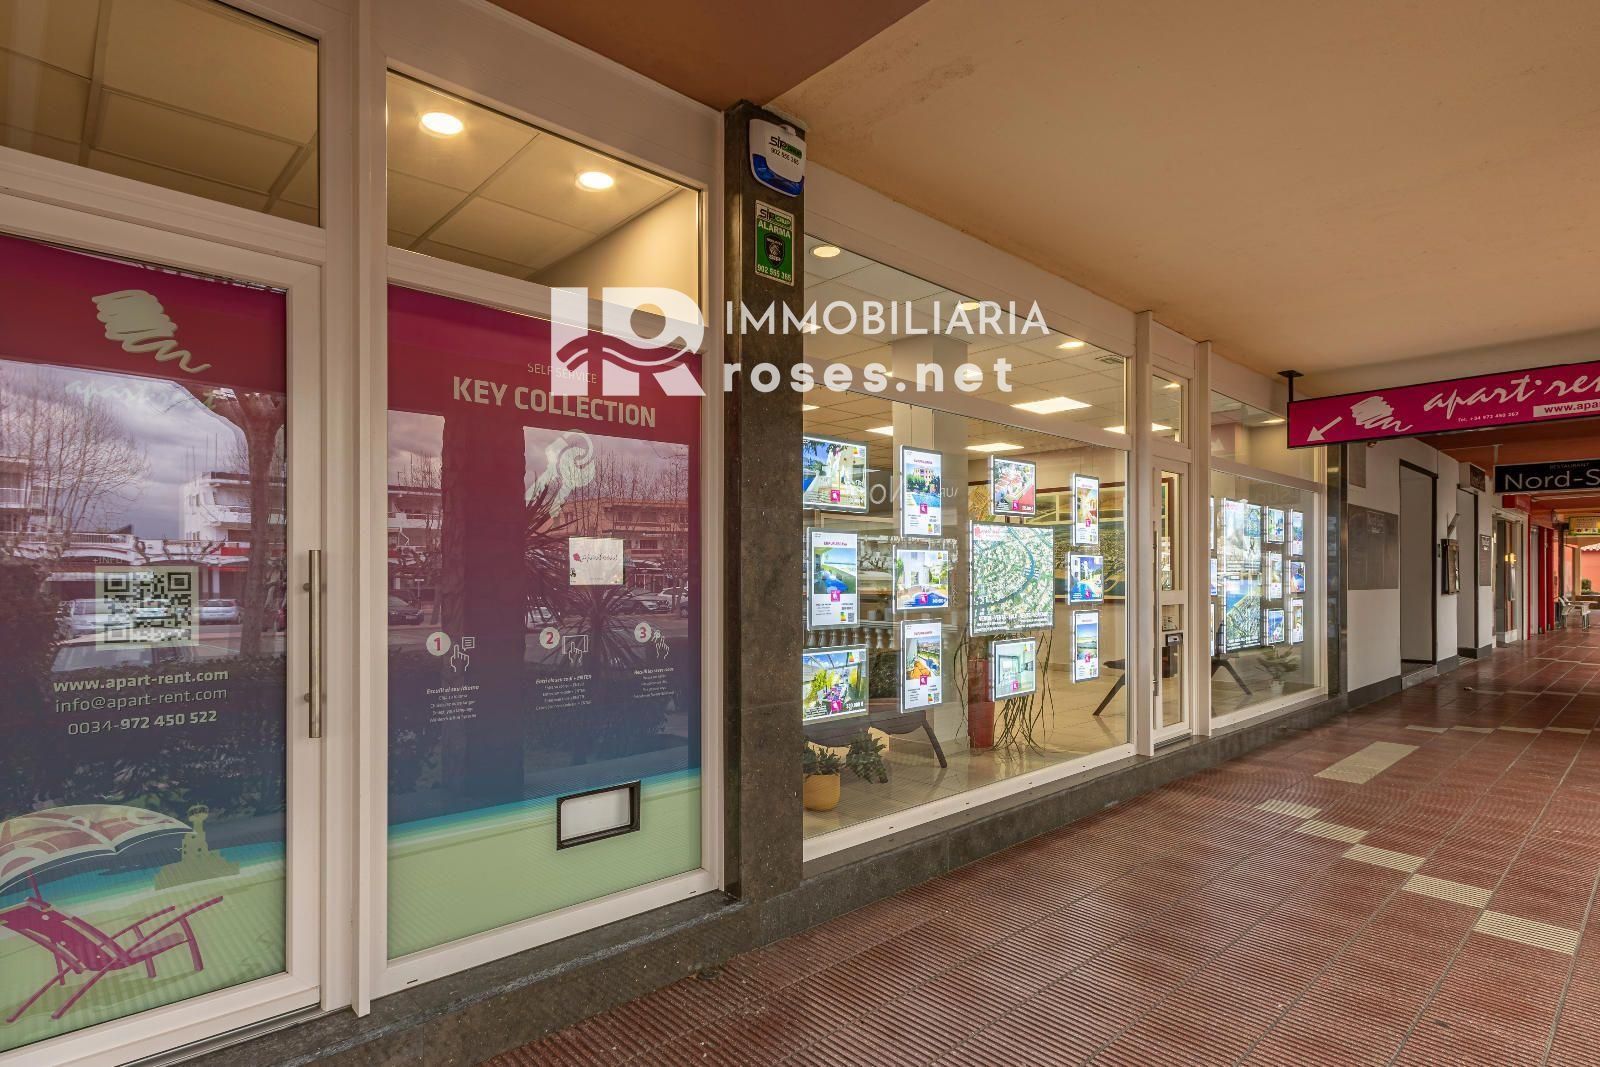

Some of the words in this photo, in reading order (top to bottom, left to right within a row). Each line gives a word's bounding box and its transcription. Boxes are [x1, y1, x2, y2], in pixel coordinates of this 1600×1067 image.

[757, 220, 791, 239] ALARMA
[757, 263, 768, 275] 902
[527, 362, 553, 376] SELF
[555, 366, 598, 385] SERVICE
[453, 375, 508, 407] KEY
[514, 386, 656, 428] COLLECTION
[1543, 398, 1600, 416] www.apa
[546, 631, 554, 645] 2
[639, 626, 647, 638] 3
[433, 637, 441, 651] 1
[53, 669, 229, 692] www.apart-rent.com
[55, 687, 227, 713] info@apart-rent.com
[68, 715, 150, 735] 0034-972
[154, 713, 186, 728] 450
[189, 710, 217, 723] 522
